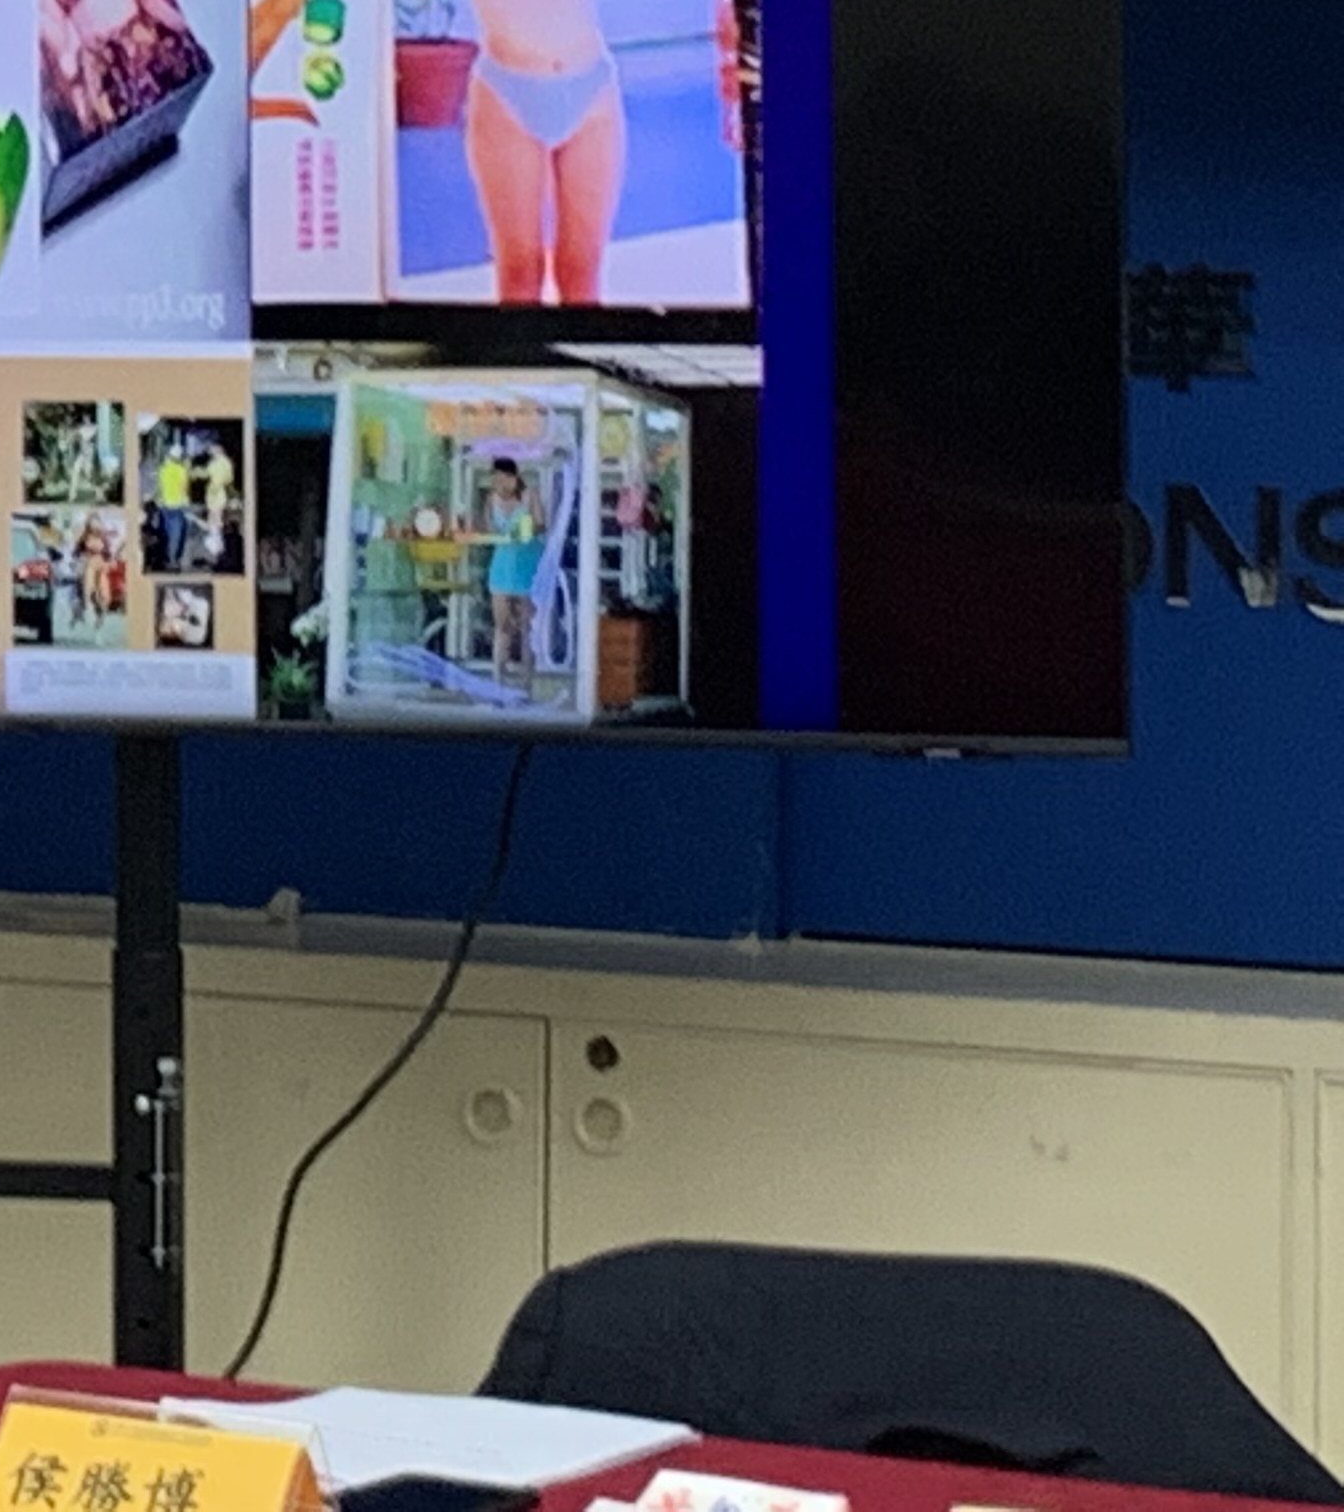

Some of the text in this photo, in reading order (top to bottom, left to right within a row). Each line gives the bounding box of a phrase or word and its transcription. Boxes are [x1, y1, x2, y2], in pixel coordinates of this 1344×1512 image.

[1124, 482, 1344, 624] NS
[10, 1450, 205, 1512] 侯勝博
